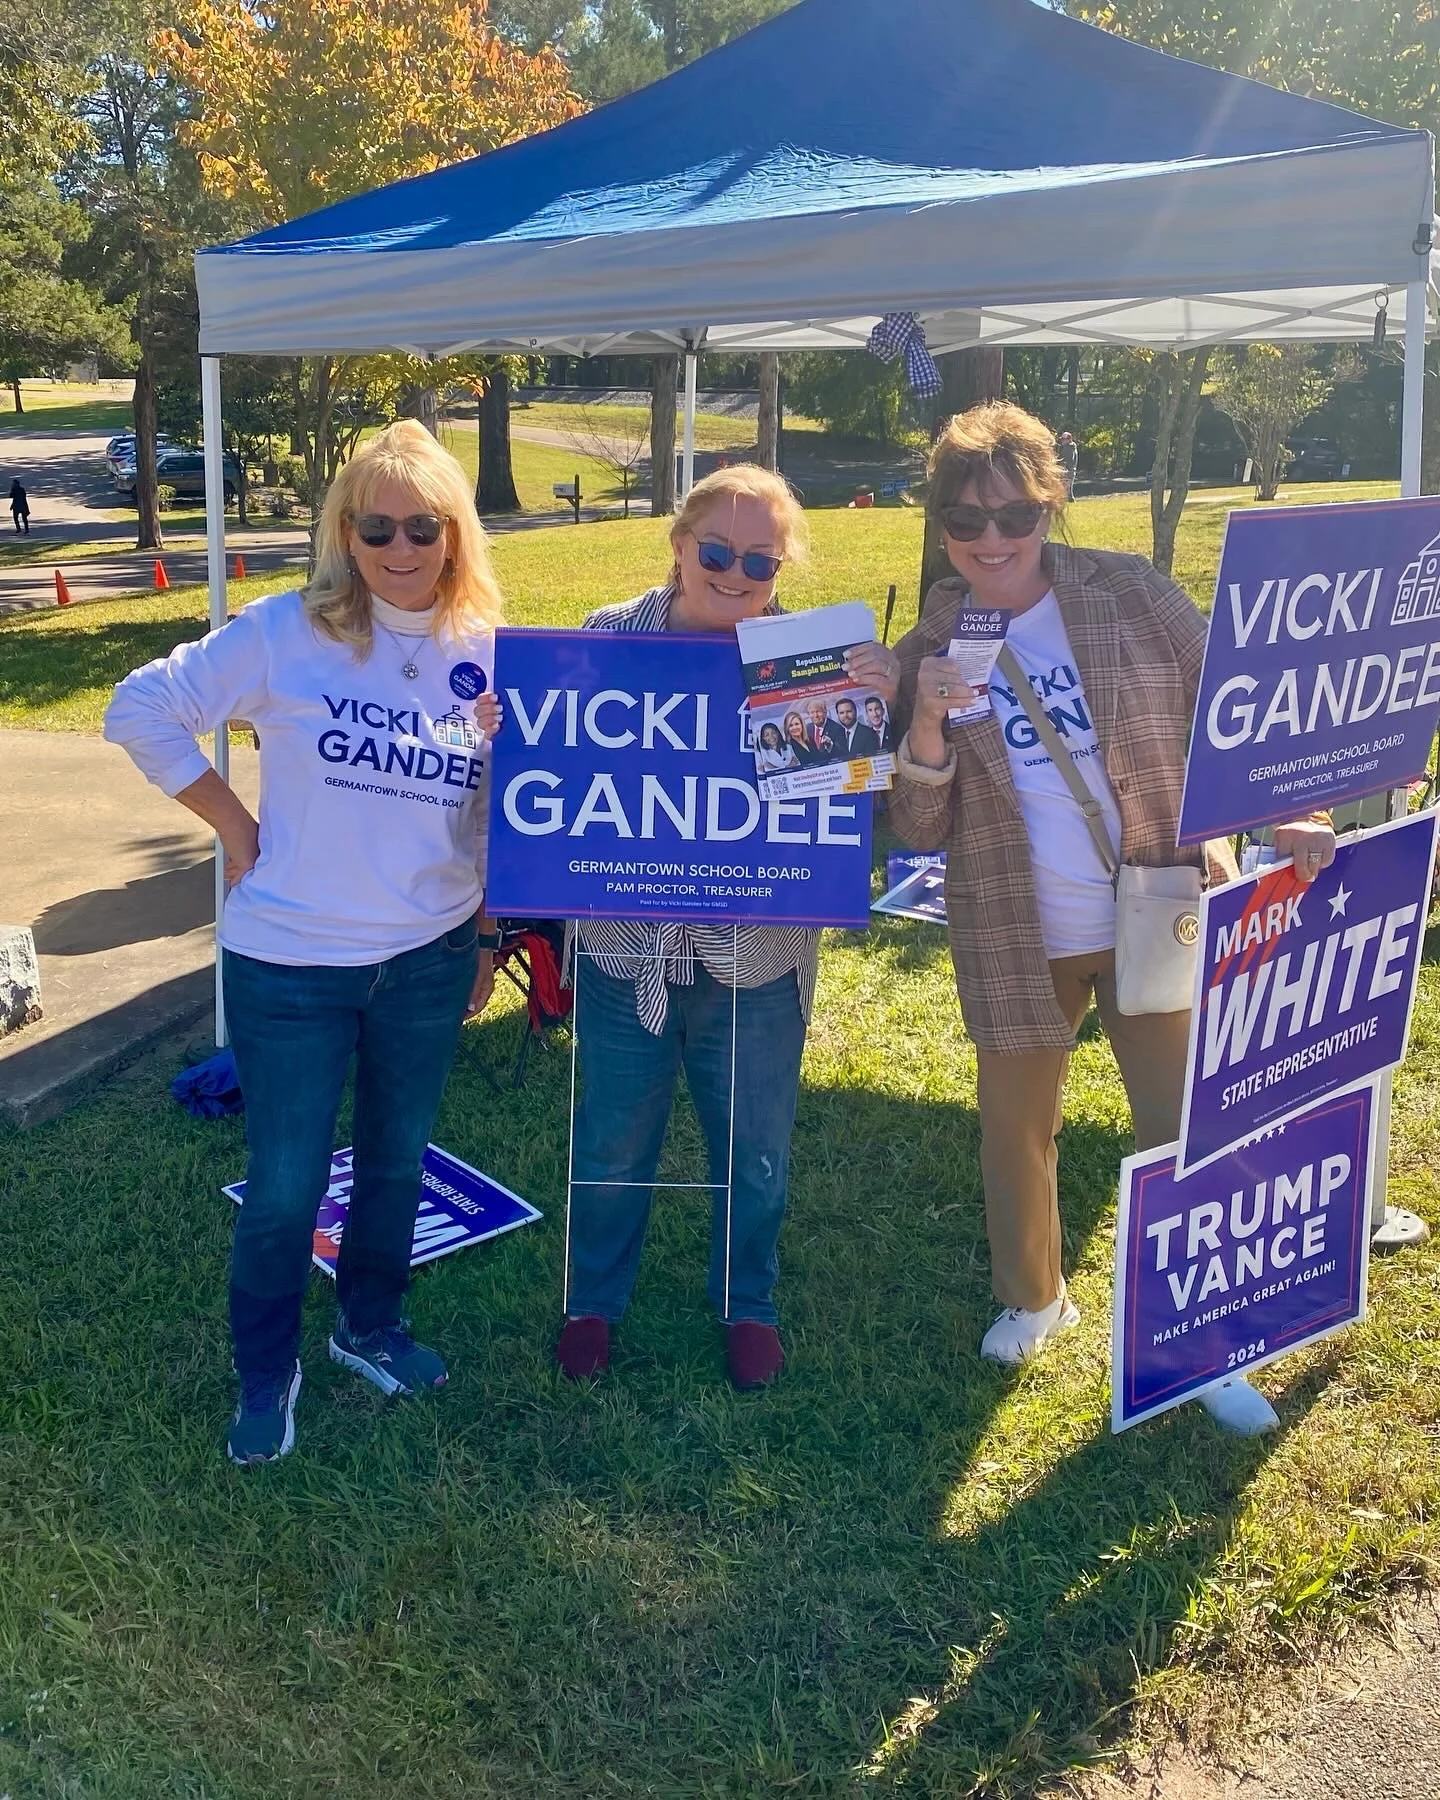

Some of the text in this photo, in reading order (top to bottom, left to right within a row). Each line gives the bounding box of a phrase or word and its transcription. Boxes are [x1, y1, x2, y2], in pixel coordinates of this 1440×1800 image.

[960, 622, 1003, 632] GANDEE
[963, 613, 988, 622] VICKI
[1228, 567, 1384, 648] VICKI
[791, 662, 841, 678] Sample Ballot
[795, 655, 833, 667] Republican
[321, 693, 420, 737] VICKI
[505, 688, 710, 751] VICKI
[1206, 642, 1440, 751] GANDEE
[318, 729, 484, 791] GANDEE
[1249, 733, 1404, 782] GERMANTOWN SCHOOL BOARD
[1272, 781, 1292, 795] PAM
[1336, 759, 1379, 780] TREASURER
[324, 776, 465, 809] GERMANTOWN SCHOOL BOAR
[502, 769, 861, 847] GANDEE
[568, 860, 811, 880] GERMANTOWN SCHOOL BOARD
[606, 882, 635, 893] PAM
[703, 885, 773, 898] TREASURER
[1214, 891, 1306, 964] MARK
[1202, 902, 1418, 1081] WHITE
[1221, 1073, 1264, 1111] STATE
[1266, 1016, 1379, 1084] REPRESENTATIVE
[447, 1192, 485, 1215] STATE
[1146, 1153, 1351, 1272] TRUMP
[1167, 1214, 1327, 1312] VANCE
[1153, 1260, 1336, 1347] MAKE AMERICA GREAT AGAIN!
[1227, 1338, 1266, 1368] 2024
